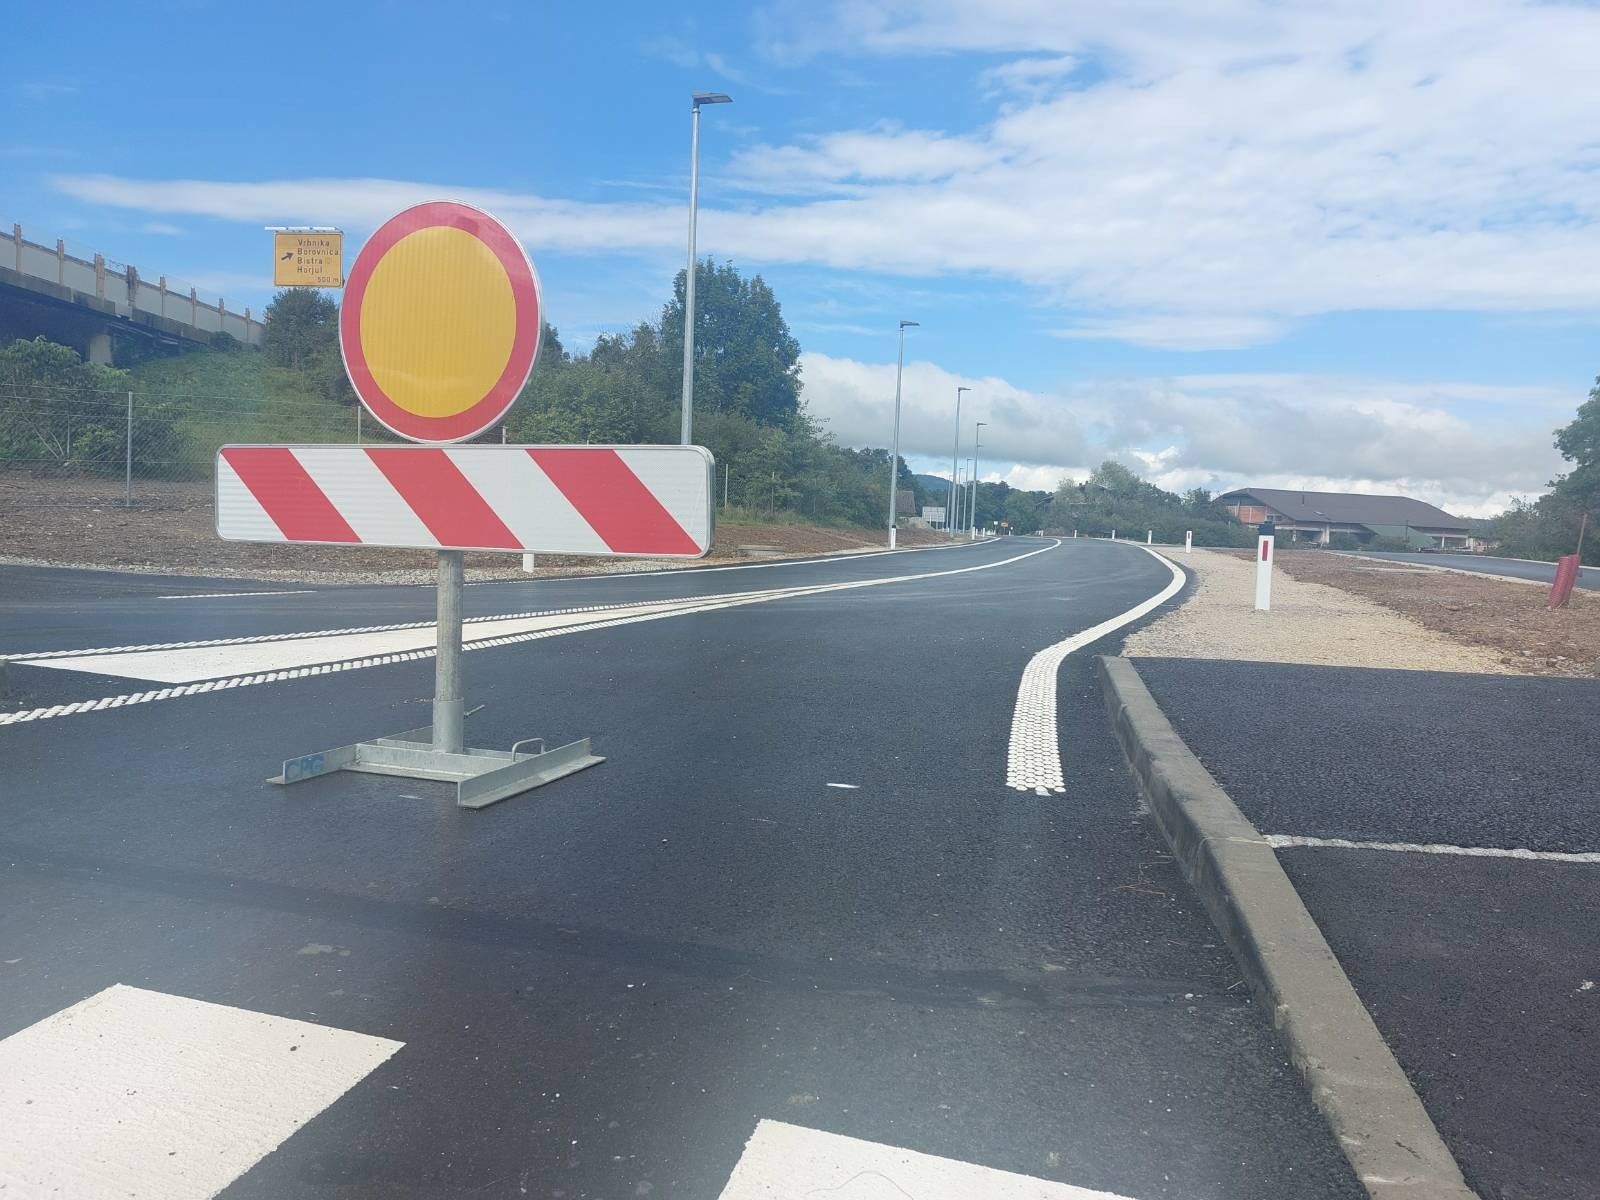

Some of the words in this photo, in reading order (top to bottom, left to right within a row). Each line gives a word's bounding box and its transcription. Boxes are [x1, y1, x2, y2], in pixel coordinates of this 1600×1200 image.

[297, 239, 330, 247] Vrhnika
[297, 248, 339, 256] Borovnica
[297, 257, 322, 265] Bistra
[297, 266, 322, 275] Horjul
